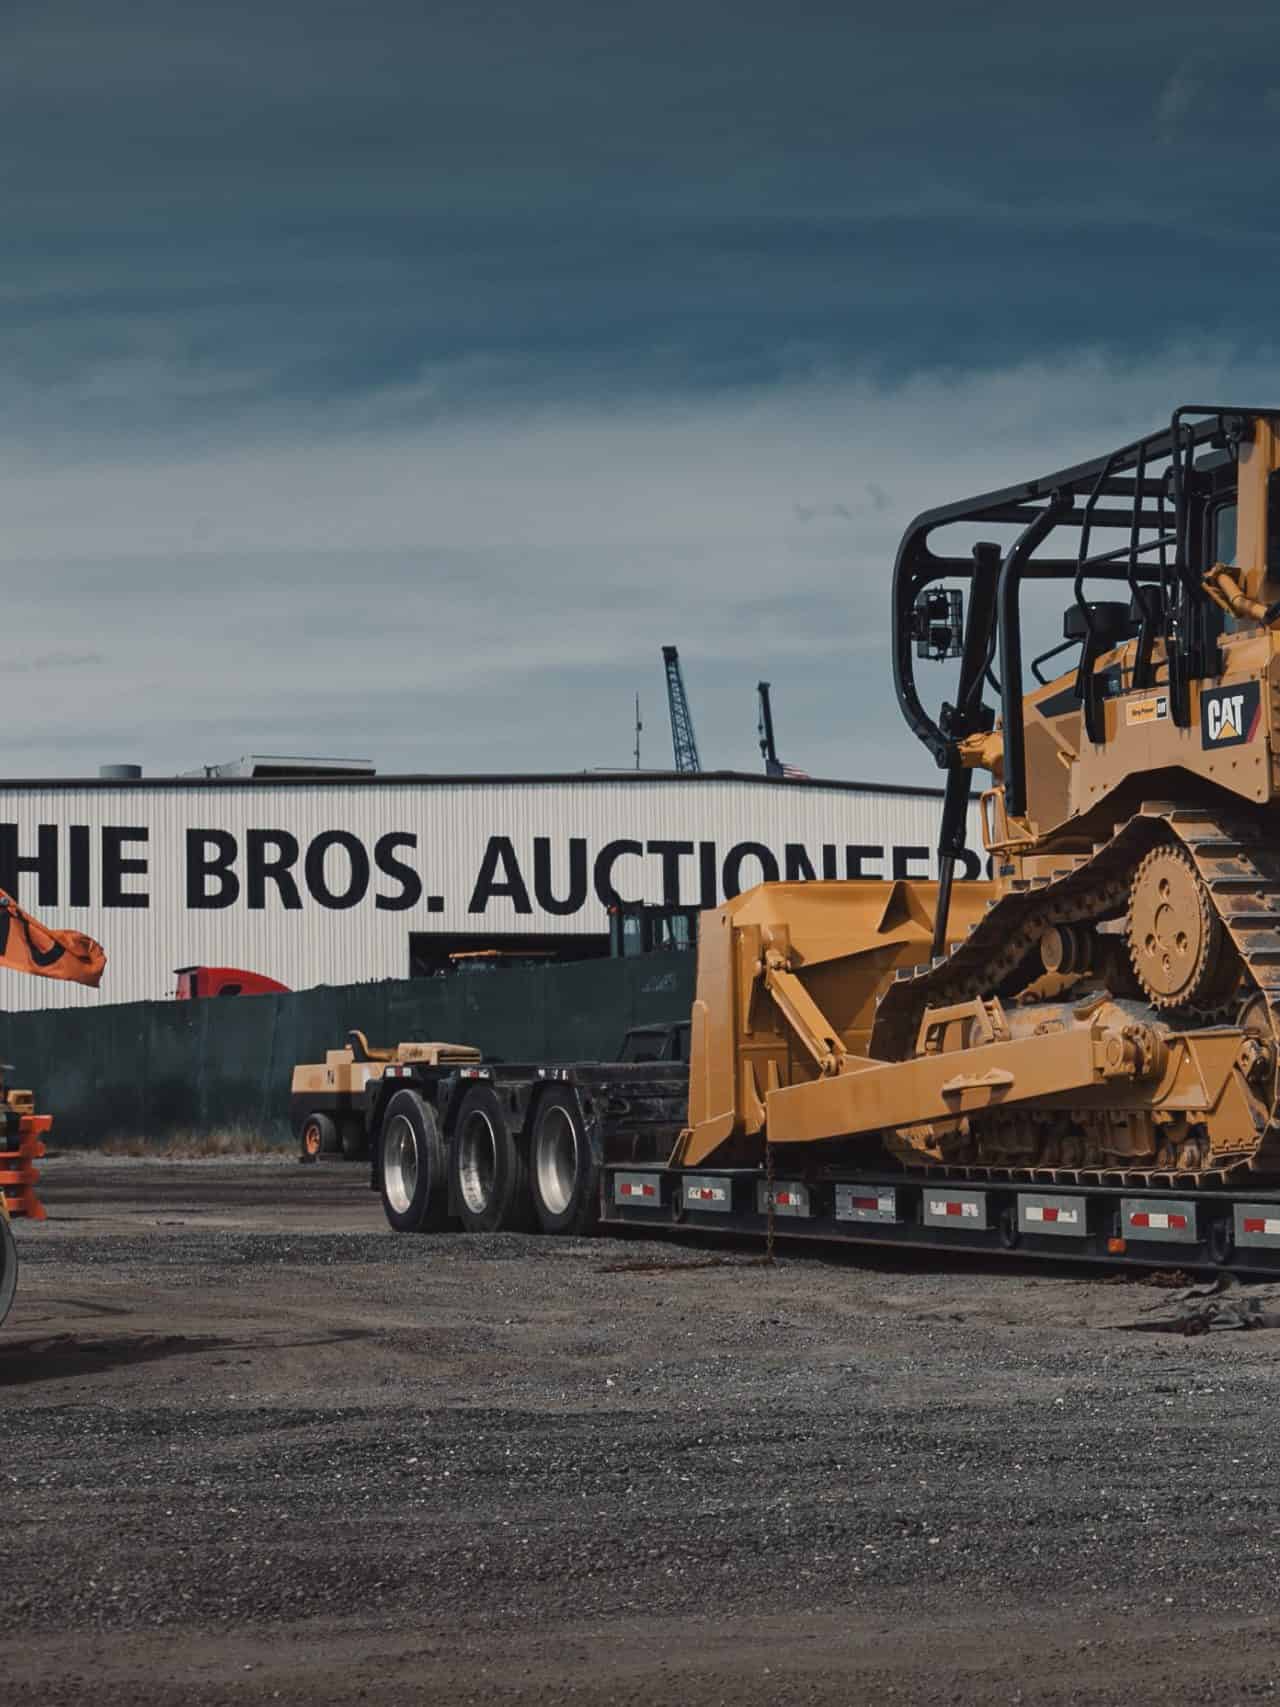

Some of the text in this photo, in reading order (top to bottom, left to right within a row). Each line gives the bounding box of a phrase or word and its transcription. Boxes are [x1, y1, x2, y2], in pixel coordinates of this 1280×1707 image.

[1208, 695, 1244, 740] CAT
[186, 828, 444, 912] BROS.
[467, 835, 994, 915] AUCTIONEE
